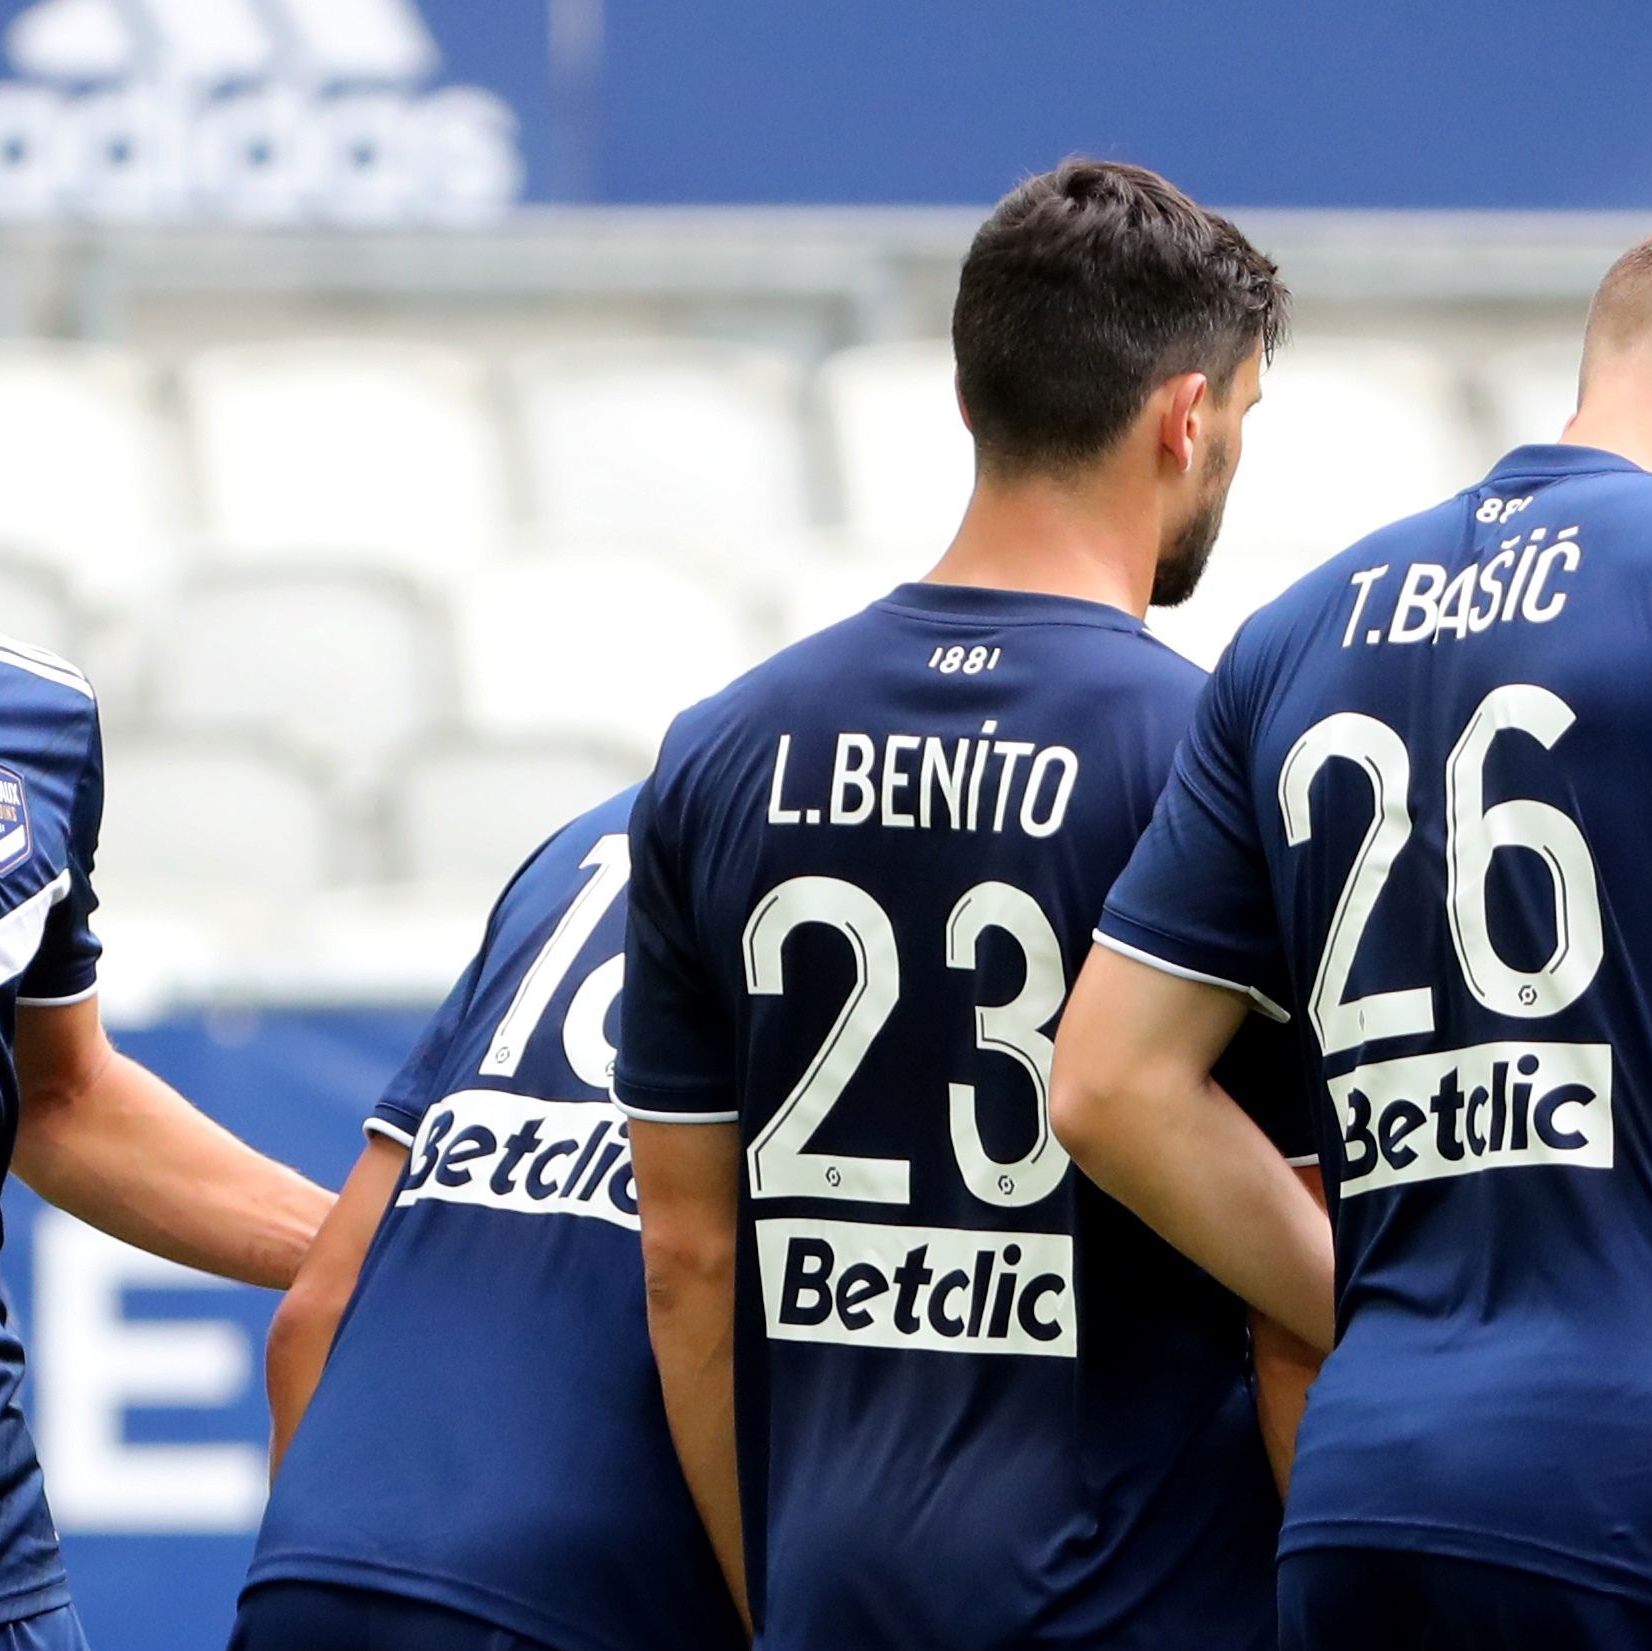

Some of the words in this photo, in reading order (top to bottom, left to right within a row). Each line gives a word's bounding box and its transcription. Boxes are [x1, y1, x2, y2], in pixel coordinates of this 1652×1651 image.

[928, 646, 1001, 673] 1881
[1278, 684, 1603, 1057] 26
[743, 876, 1071, 1207] 23
[1341, 1054, 1596, 1183] Betclic
[779, 1237, 1067, 1340] Betclic
